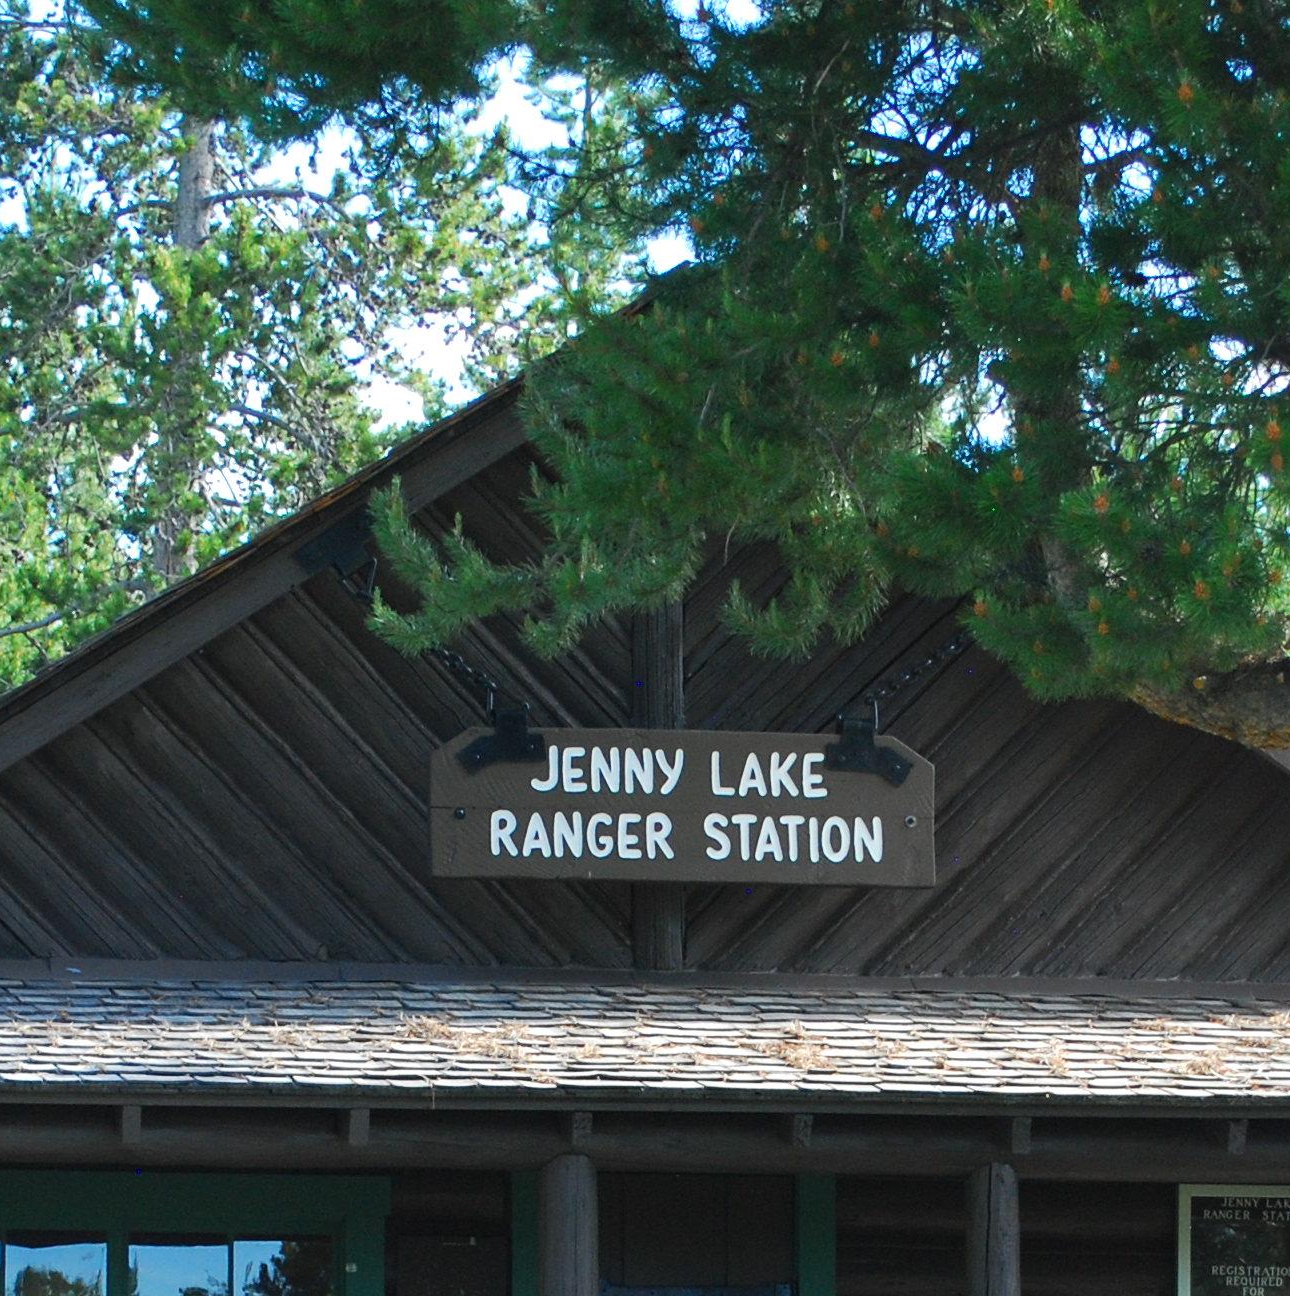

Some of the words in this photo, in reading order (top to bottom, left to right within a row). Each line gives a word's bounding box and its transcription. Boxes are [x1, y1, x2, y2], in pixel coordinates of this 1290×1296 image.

[530, 745, 684, 796] JENNY
[710, 751, 828, 799] LAKE
[490, 809, 675, 861] RANGER
[703, 812, 883, 864] STATION
[1220, 1197, 1259, 1209] JENNY
[1202, 1209, 1251, 1221] RANGER
[1225, 1276, 1284, 1288] REQUIRED
